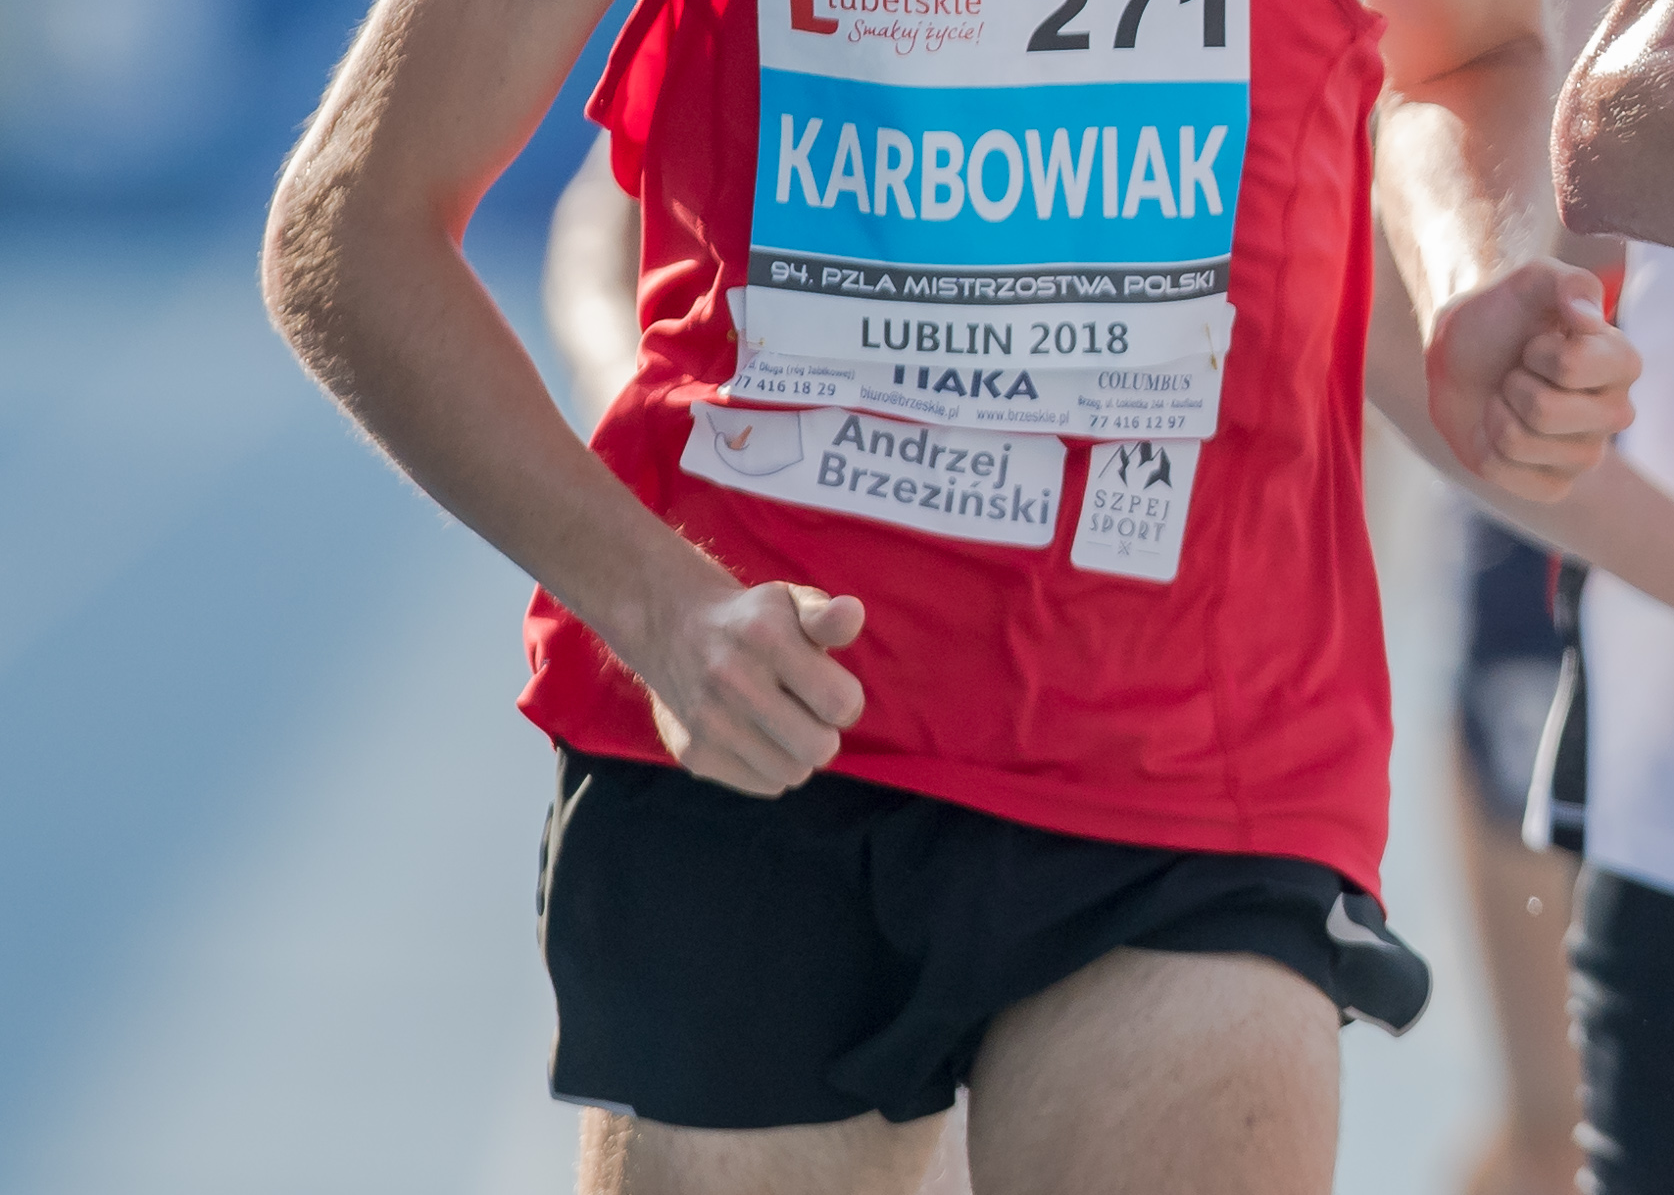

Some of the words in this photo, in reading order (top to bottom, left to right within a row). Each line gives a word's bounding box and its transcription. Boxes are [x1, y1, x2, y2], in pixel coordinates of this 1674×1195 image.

[847, 19, 922, 55] Smakuj
[774, 113, 1229, 222] KARBOWIAK
[770, 260, 815, 286] 94.
[821, 267, 897, 294] PZLA
[902, 273, 1117, 298] MISTRZOSTWA
[1123, 269, 1216, 296] POLSKI
[861, 316, 1013, 355] LUBLIN
[1029, 320, 1130, 355] 2018
[757, 378, 786, 393] 416
[793, 380, 811, 395] 18
[817, 381, 837, 396] 29
[1098, 370, 1193, 392] COLUMBUS
[859, 385, 960, 419] biuro@brzeskie.pl
[976, 408, 1070, 424] www.brzeskie.pl
[1090, 413, 1109, 428] 77
[1113, 415, 1140, 429] 416
[1146, 415, 1163, 429] 12
[1167, 415, 1186, 429] 97
[832, 414, 1013, 489] Andrzej
[816, 450, 1052, 525] Brzeziński
[1093, 488, 1171, 520] SZPEJ
[1089, 512, 1167, 543] SPORT
